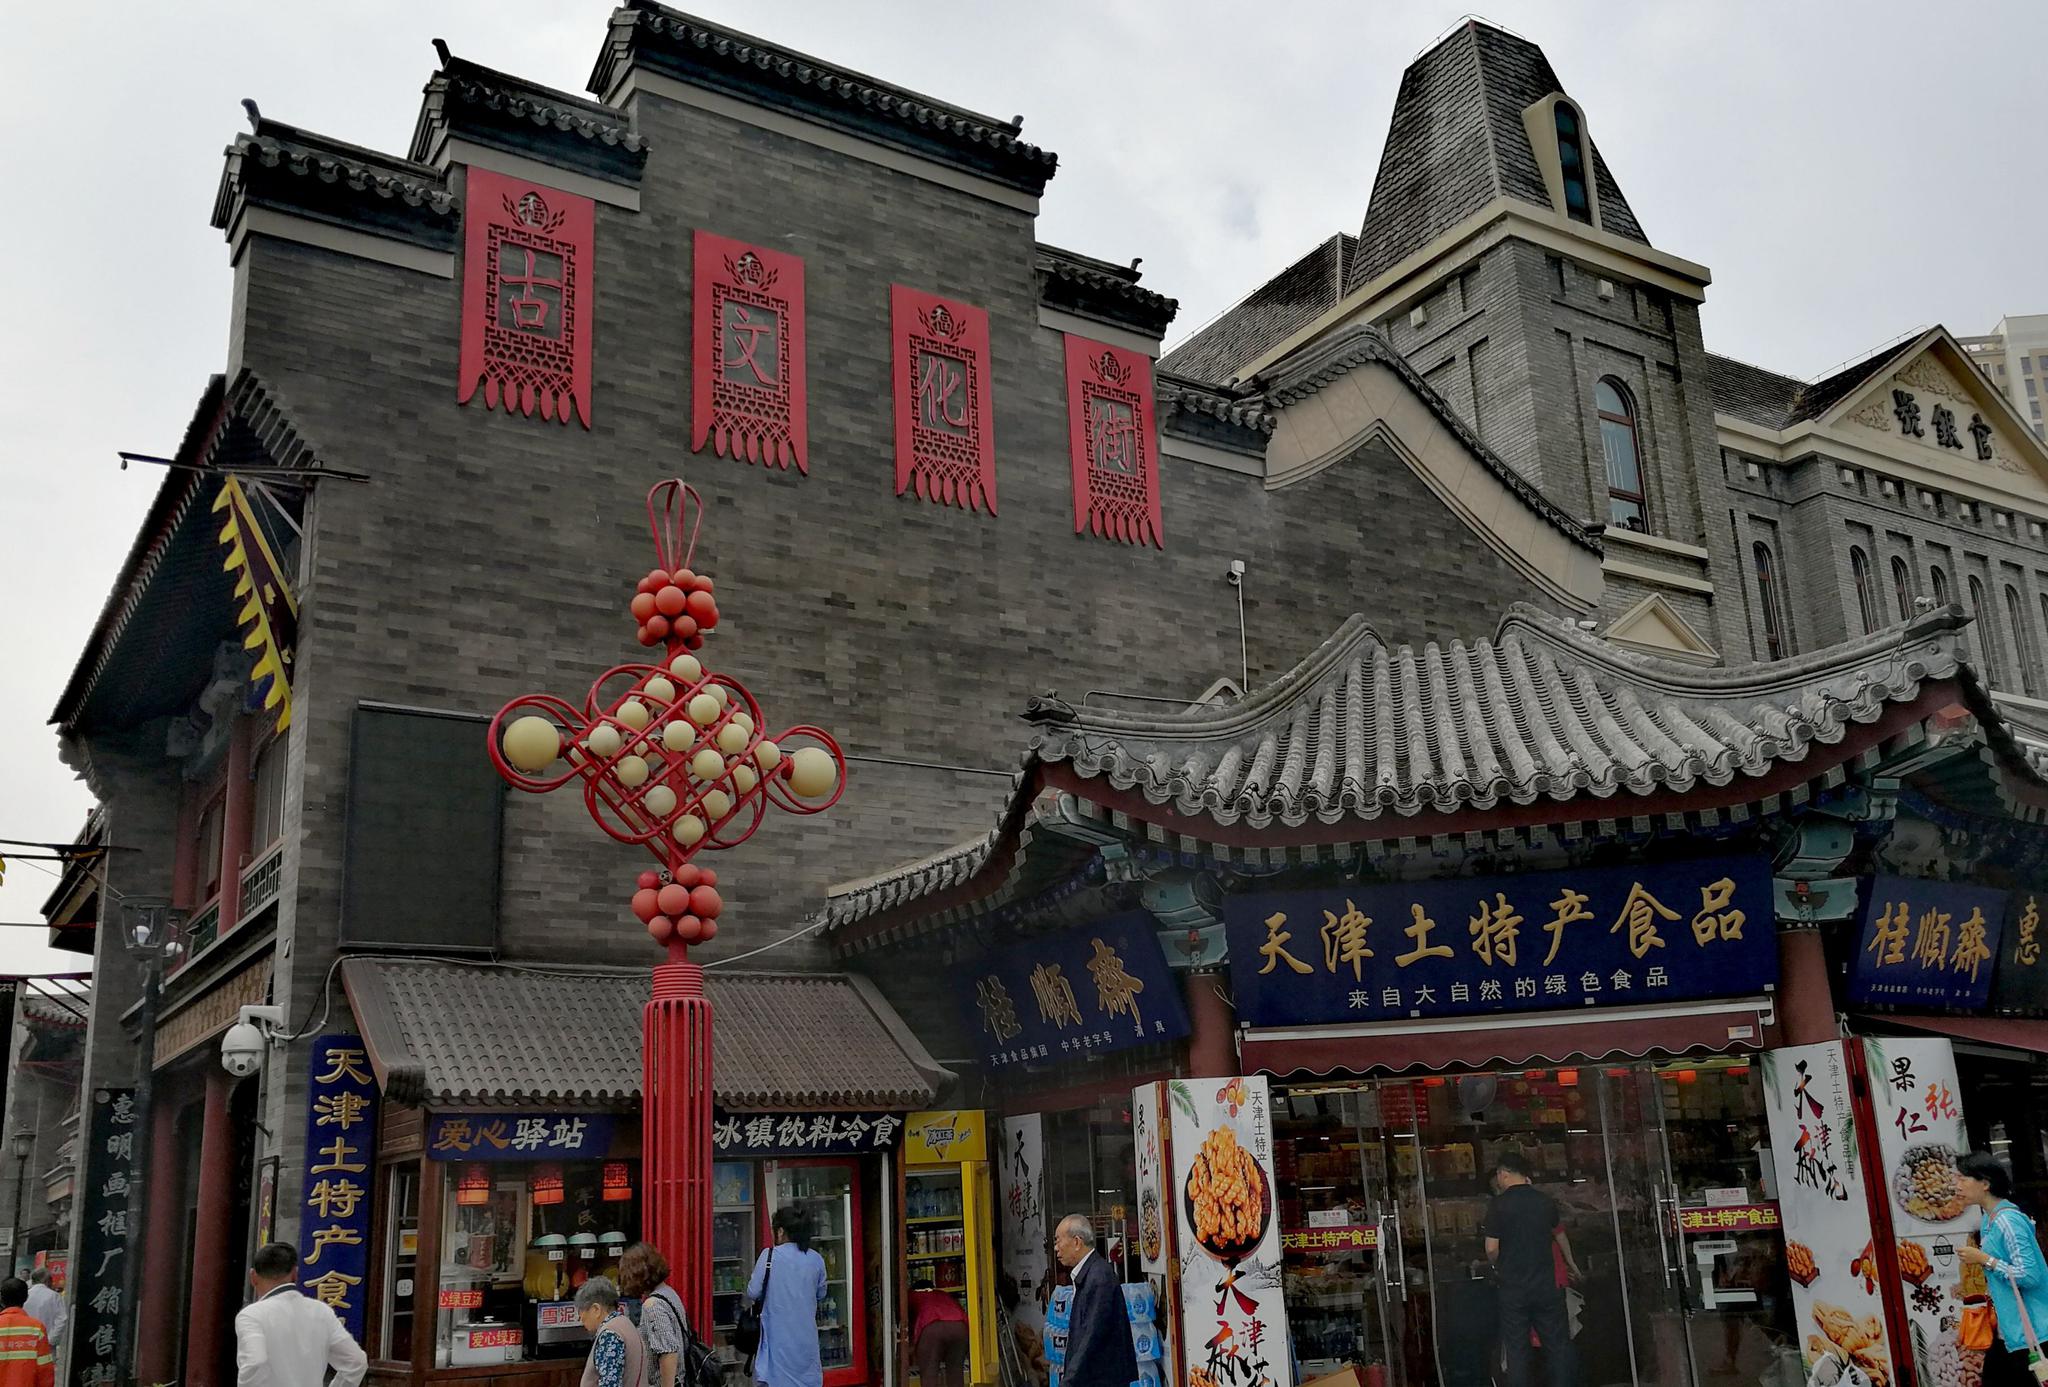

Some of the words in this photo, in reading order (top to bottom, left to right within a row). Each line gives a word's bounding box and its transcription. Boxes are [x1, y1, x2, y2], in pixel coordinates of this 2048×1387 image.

[500, 249, 563, 329] 古
[726, 307, 779, 388] 文
[918, 355, 969, 429] 化
[1092, 403, 1134, 473] 街
[1257, 876, 1747, 983] 天津土特产食品
[1347, 966, 1668, 1010] 来自大自然的绿色食品
[990, 1043, 1049, 1067] 天津食品集团
[1060, 1030, 1113, 1053] 中华老字号
[432, 1116, 588, 1152] 爱心驿站
[712, 1113, 902, 1150] 冰镇饮料冷食
[303, 1047, 374, 1326] 天津土特产食
[1281, 1229, 1378, 1249] 天津土特产食品
